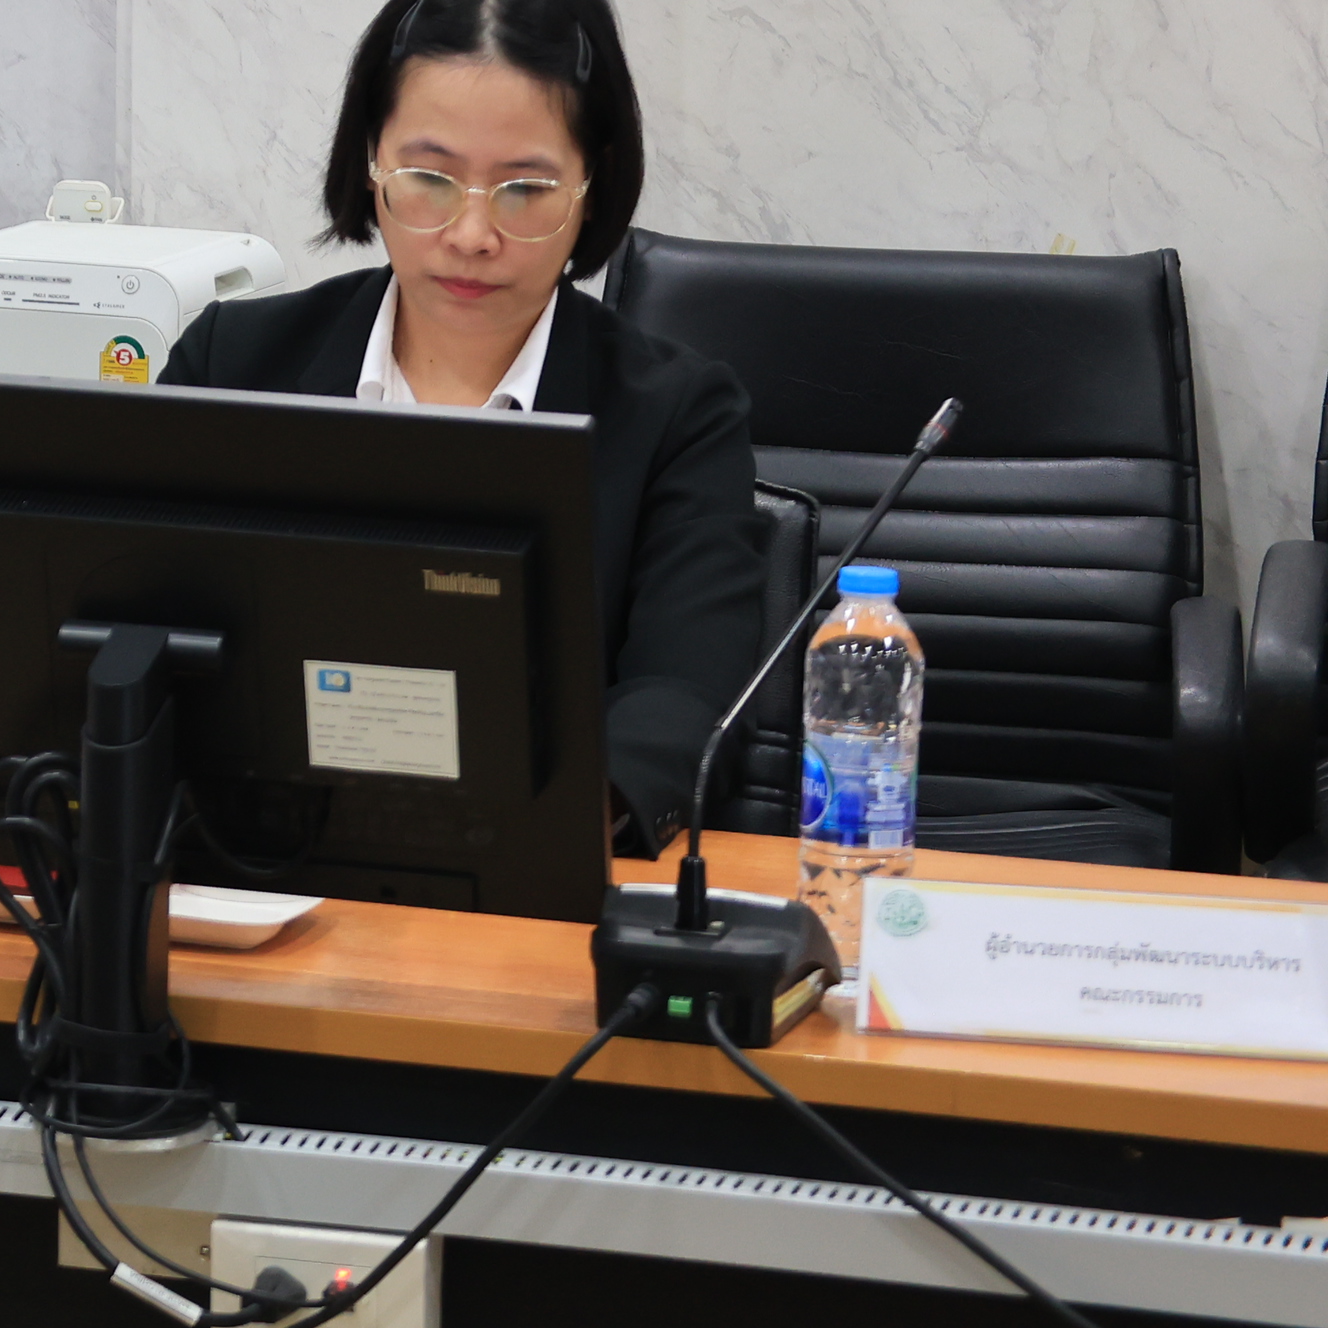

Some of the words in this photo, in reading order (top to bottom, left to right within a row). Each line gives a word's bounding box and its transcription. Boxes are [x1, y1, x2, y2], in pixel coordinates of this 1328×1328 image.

[118, 350, 130, 365] 5
[1079, 985, 1204, 1008] คณะกรรมการ
